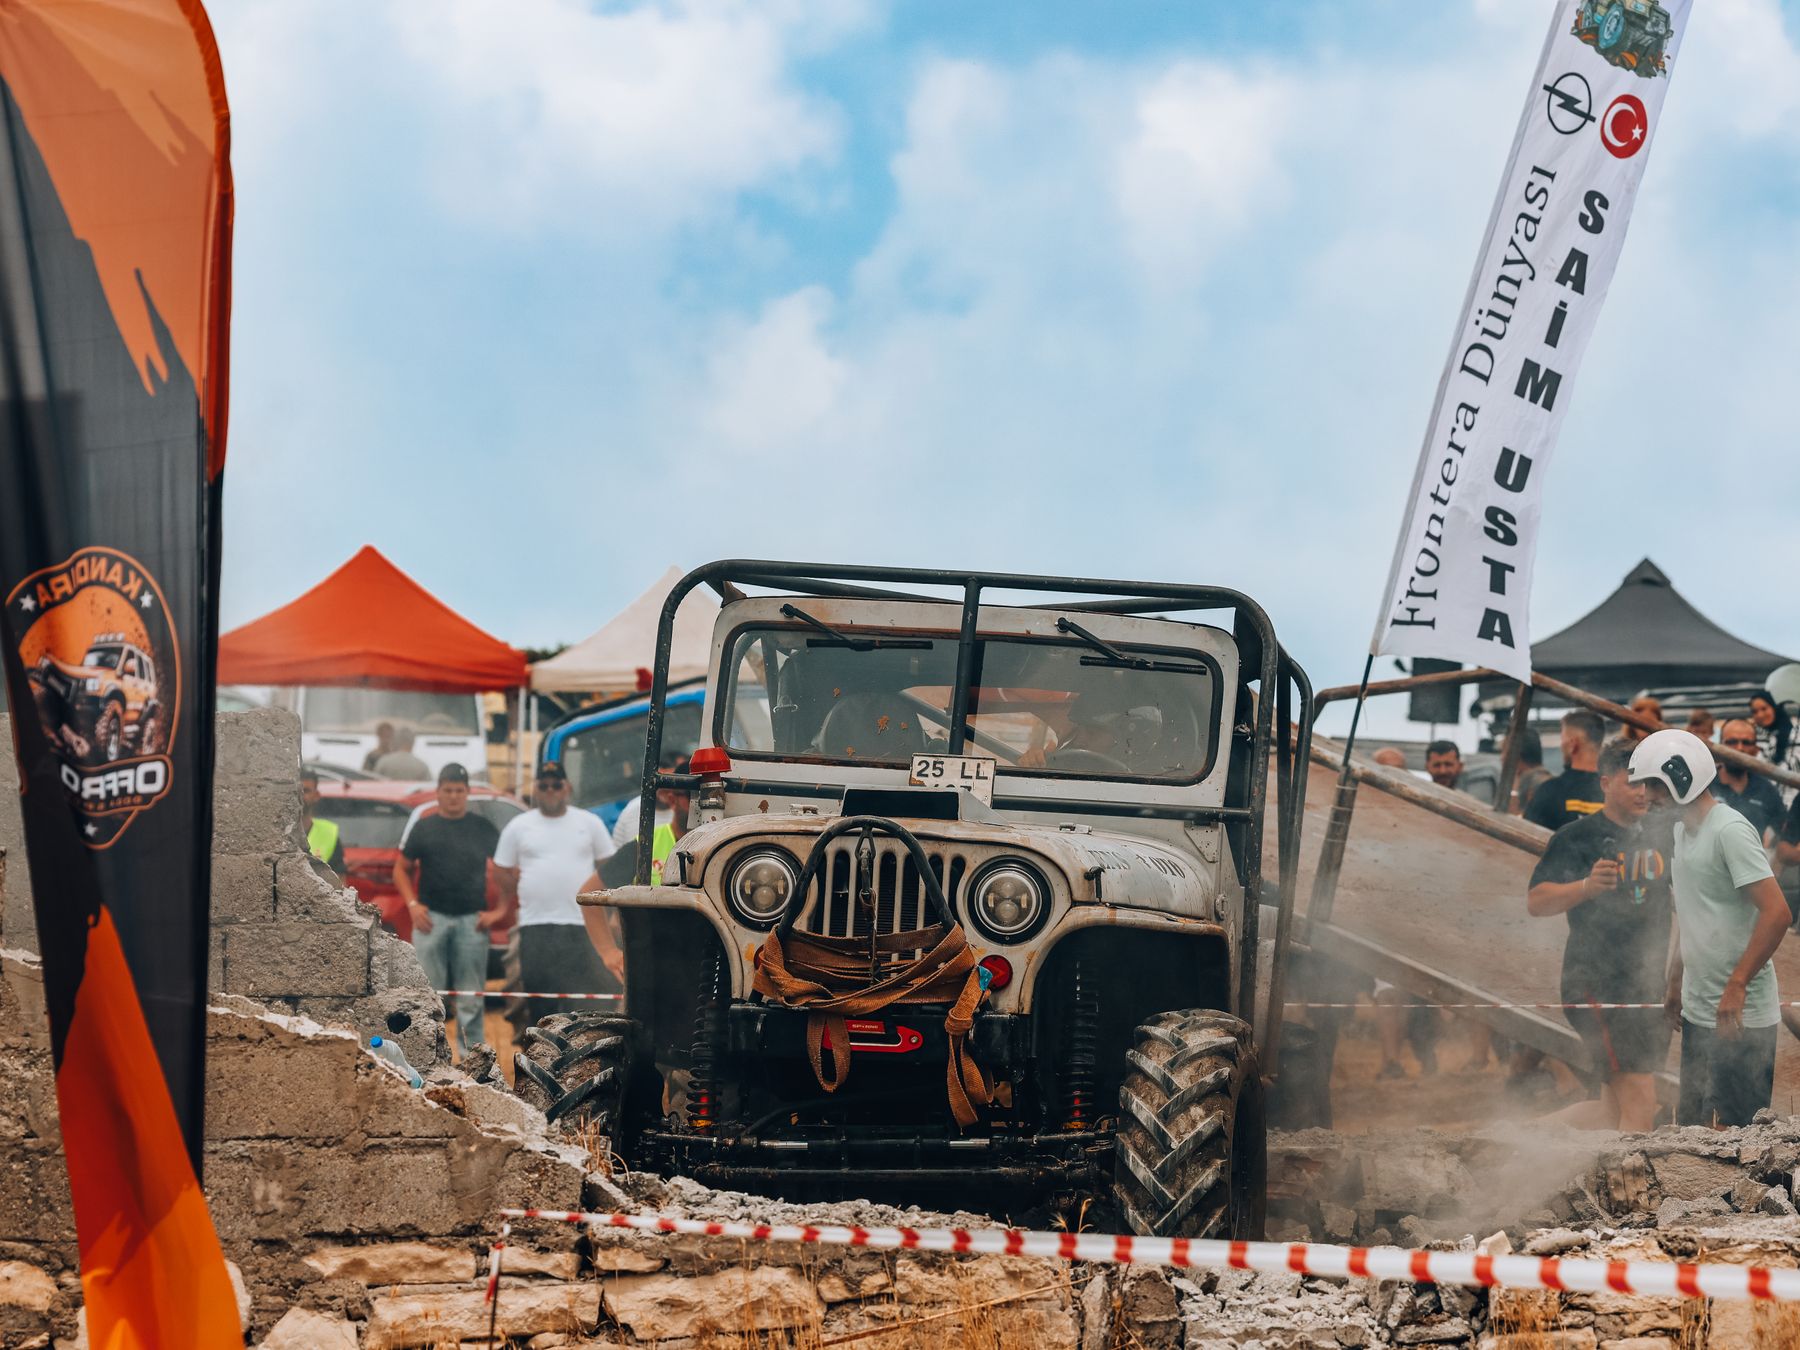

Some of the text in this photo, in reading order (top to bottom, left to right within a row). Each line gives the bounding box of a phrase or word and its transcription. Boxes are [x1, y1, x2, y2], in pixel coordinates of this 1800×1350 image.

[1391, 166, 1557, 631] Frontera Dünyası
[1477, 447, 1533, 650] USTA
[916, 760, 988, 780] 25 LL
